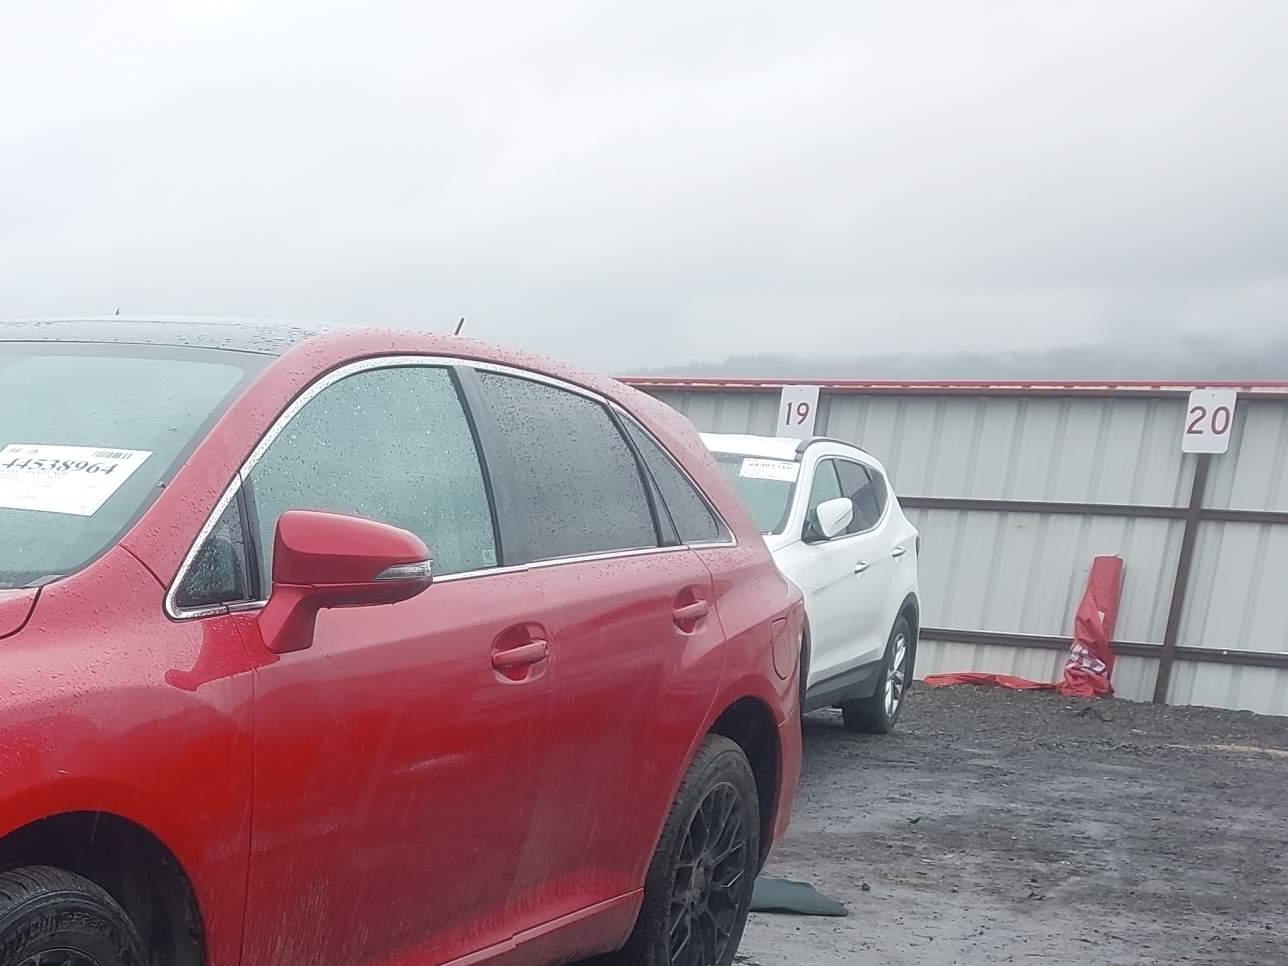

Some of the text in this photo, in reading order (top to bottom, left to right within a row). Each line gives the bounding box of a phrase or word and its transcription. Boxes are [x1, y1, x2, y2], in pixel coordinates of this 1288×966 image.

[785, 402, 810, 426] 19
[1186, 406, 1231, 435] 20
[1, 457, 119, 475] 44538964
